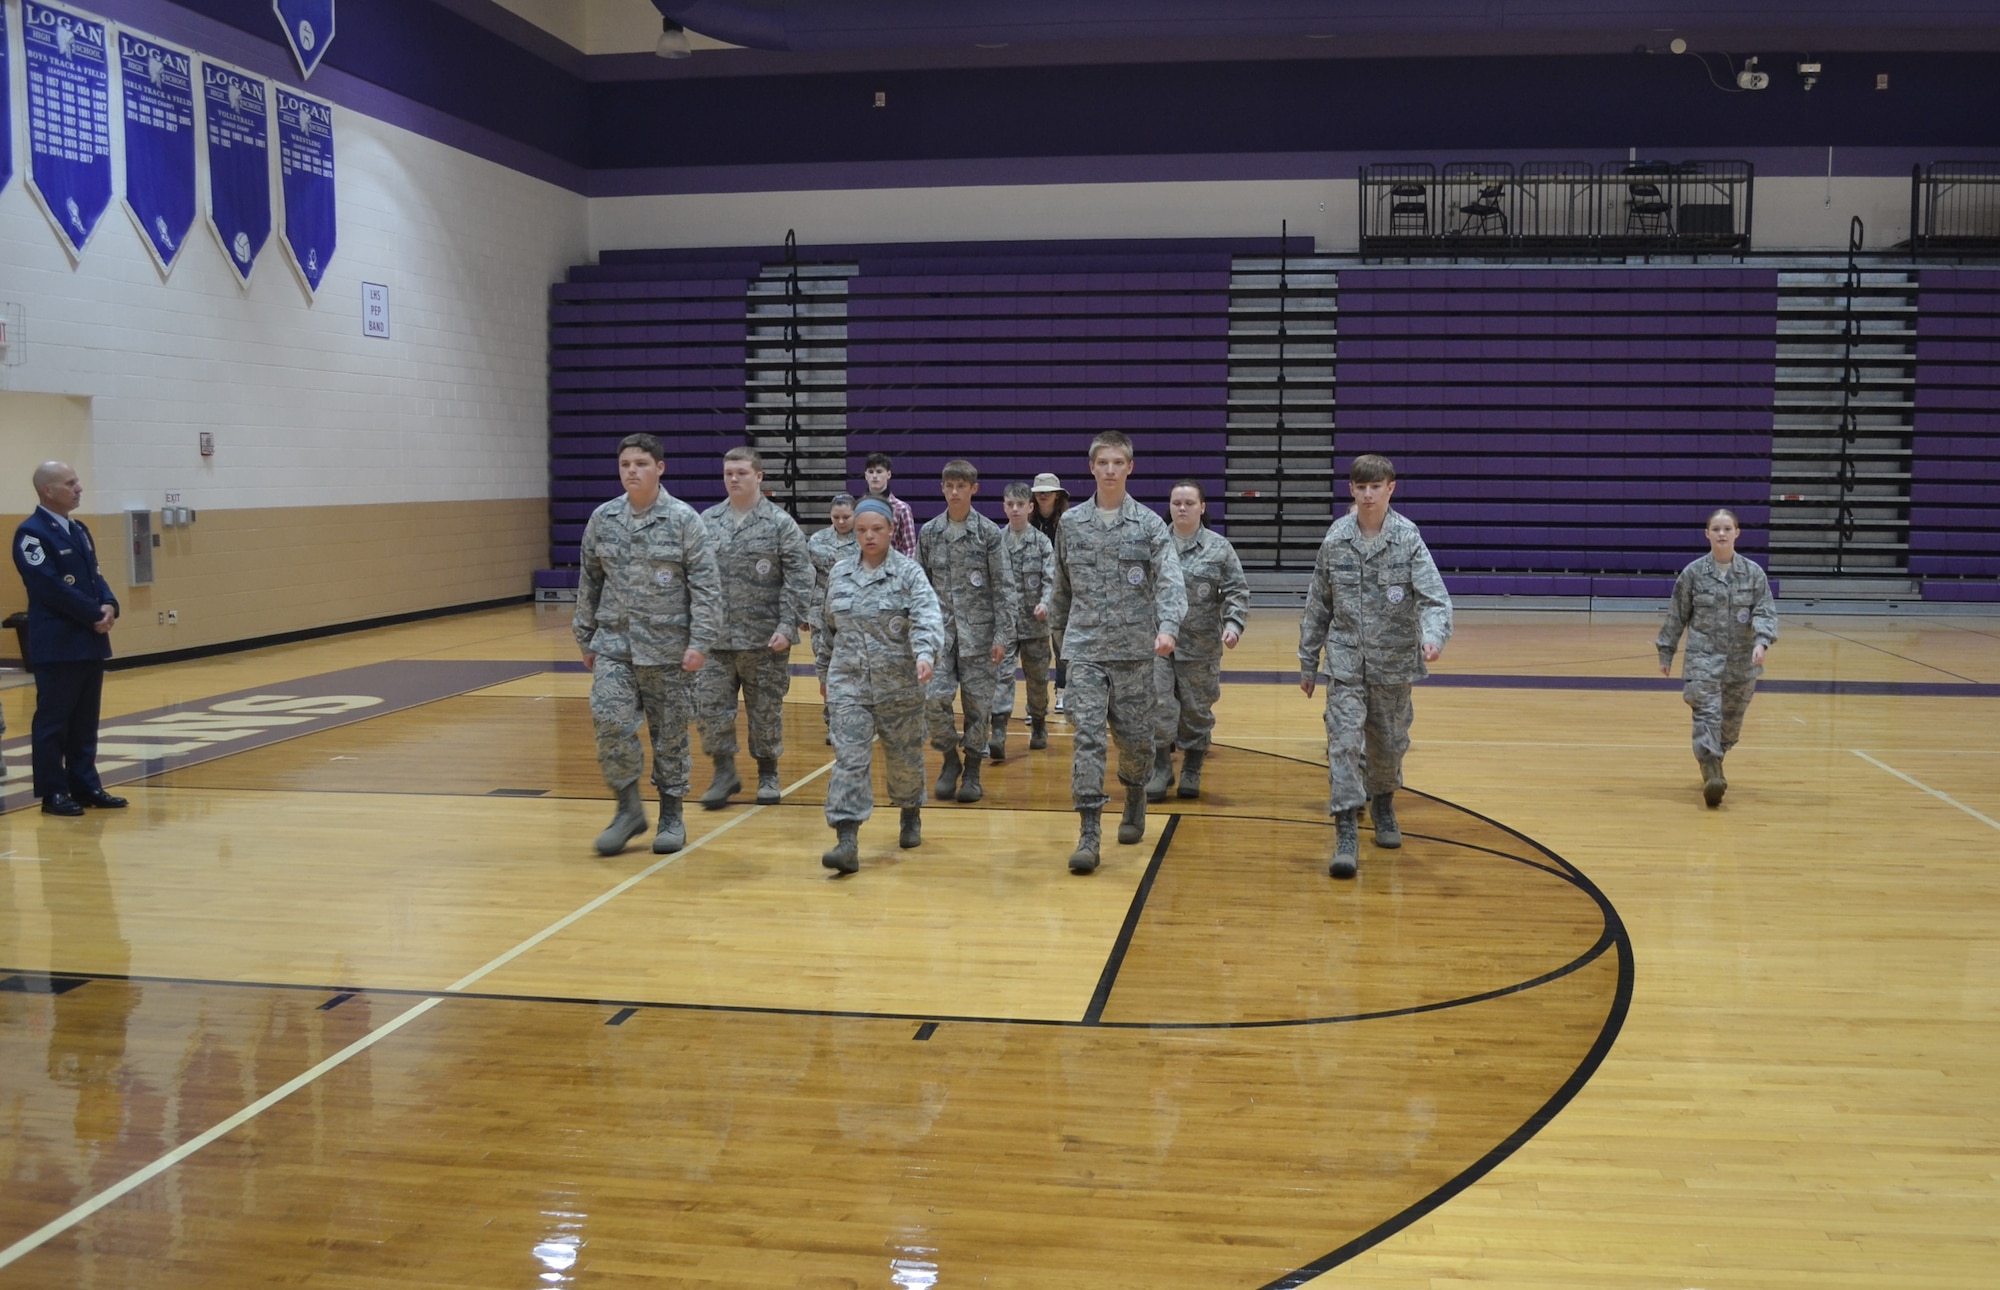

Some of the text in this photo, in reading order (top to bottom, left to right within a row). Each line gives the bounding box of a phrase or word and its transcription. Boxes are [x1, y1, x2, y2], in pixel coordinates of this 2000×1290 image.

[26, 5, 102, 46] LOGAN
[33, 30, 102, 58] HIGH SCHOOL
[28, 50, 48, 62] BOYS
[50, 56, 75, 70] TRACK
[84, 67, 106, 79] FIELD
[122, 38, 188, 76] LOGAN
[48, 67, 87, 83] LEAGUE CHAMPS
[128, 61, 186, 87] HIGH SCHOOL
[124, 79, 142, 91] GIRLS
[143, 85, 166, 99] TRACK
[173, 96, 192, 106] FIELD
[206, 67, 262, 101] LOGAN
[140, 95, 174, 110] LEAGUE CHAMPS
[210, 89, 262, 112] HIGH SCHOOL
[278, 94, 330, 124] LOGAN
[218, 109, 254, 127] VOLLEYBALL
[283, 115, 328, 135] HIGH SCHOOL
[166, 122, 178, 133] 2017
[291, 133, 321, 148] WRESTLING
[50, 146, 62, 157] 2014
[80, 153, 93, 164] 2017
[95, 146, 109, 155] 2012
[371, 290, 380, 300] LHS
[371, 305, 381, 316] PEP
[369, 320, 384, 332] BAND
[166, 493, 180, 502] EXIT
